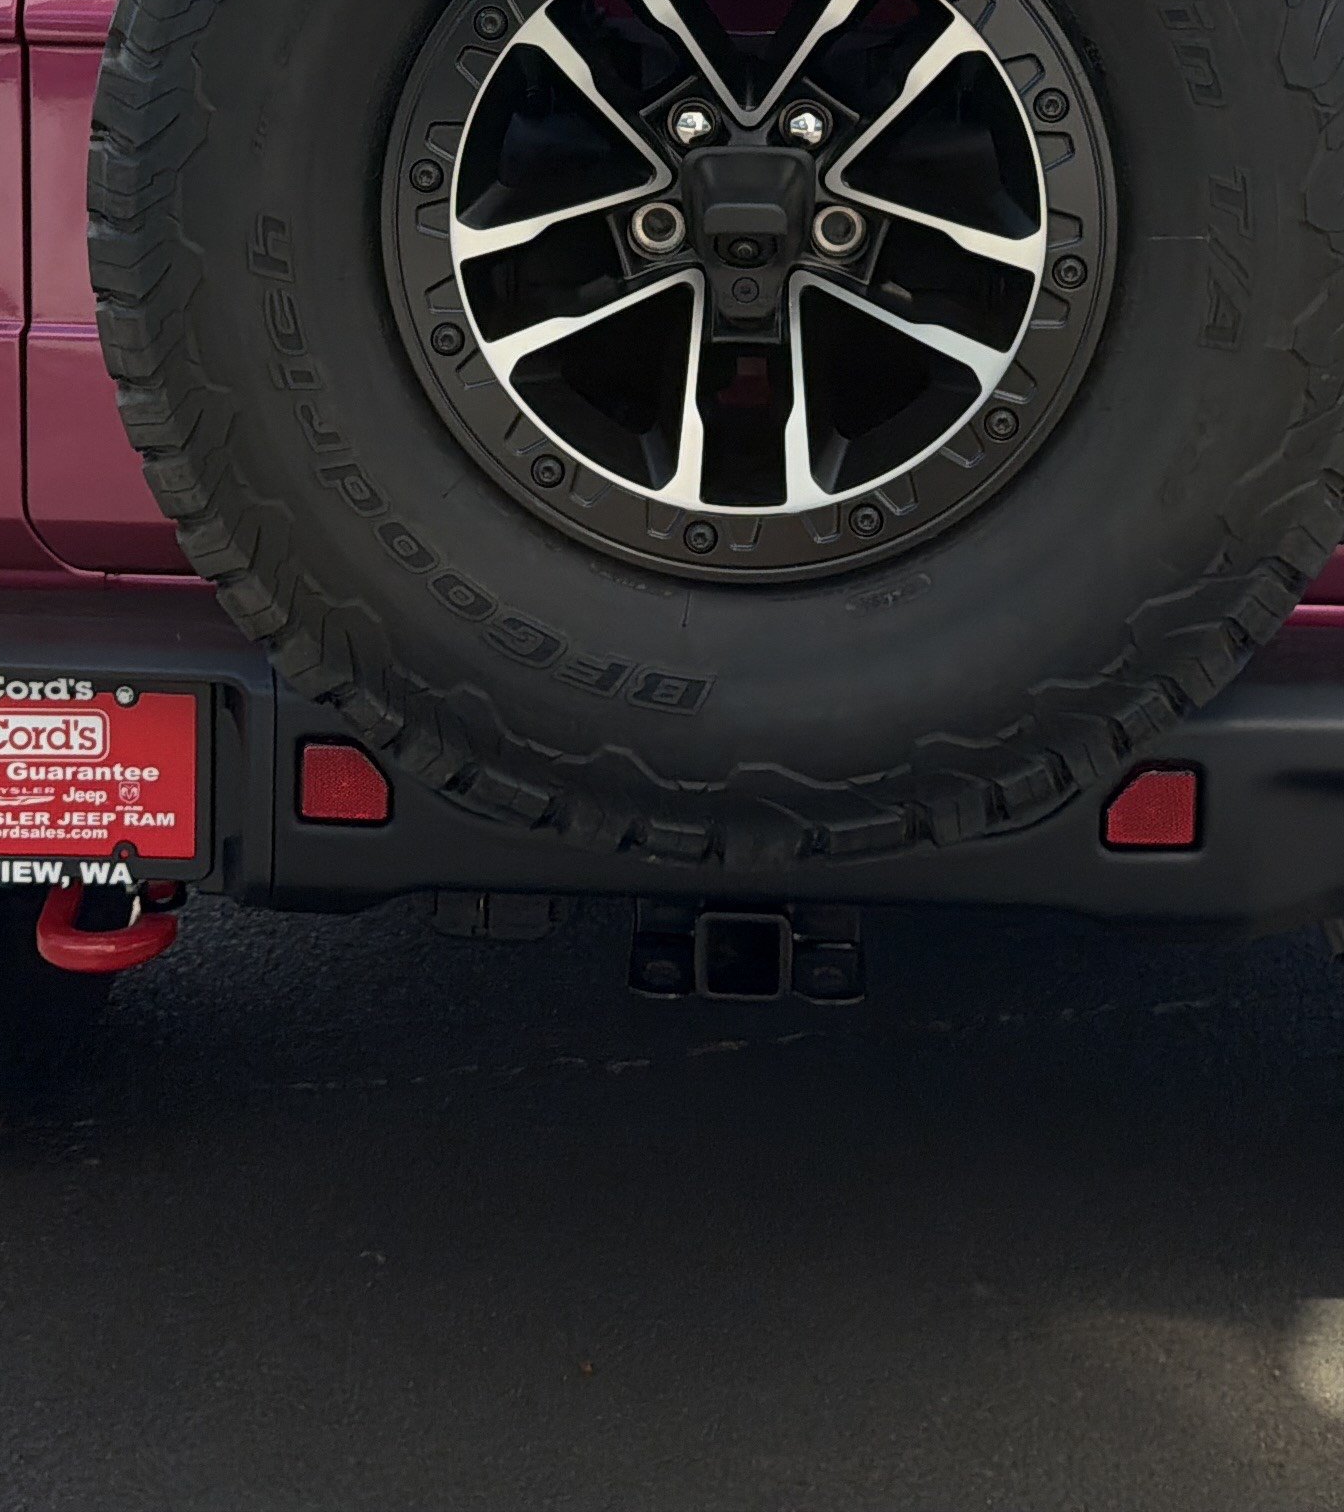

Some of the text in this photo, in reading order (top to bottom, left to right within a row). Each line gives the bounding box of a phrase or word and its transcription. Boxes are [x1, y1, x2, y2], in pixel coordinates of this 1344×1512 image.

[1199, 165, 1253, 352] T/A
[247, 212, 718, 716] BFGoodrich
[6, 762, 160, 781] Guarantee
[62, 787, 108, 806] Jeep
[57, 812, 117, 826] JEEP
[124, 813, 175, 827] RAM
[80, 862, 132, 885] WA
